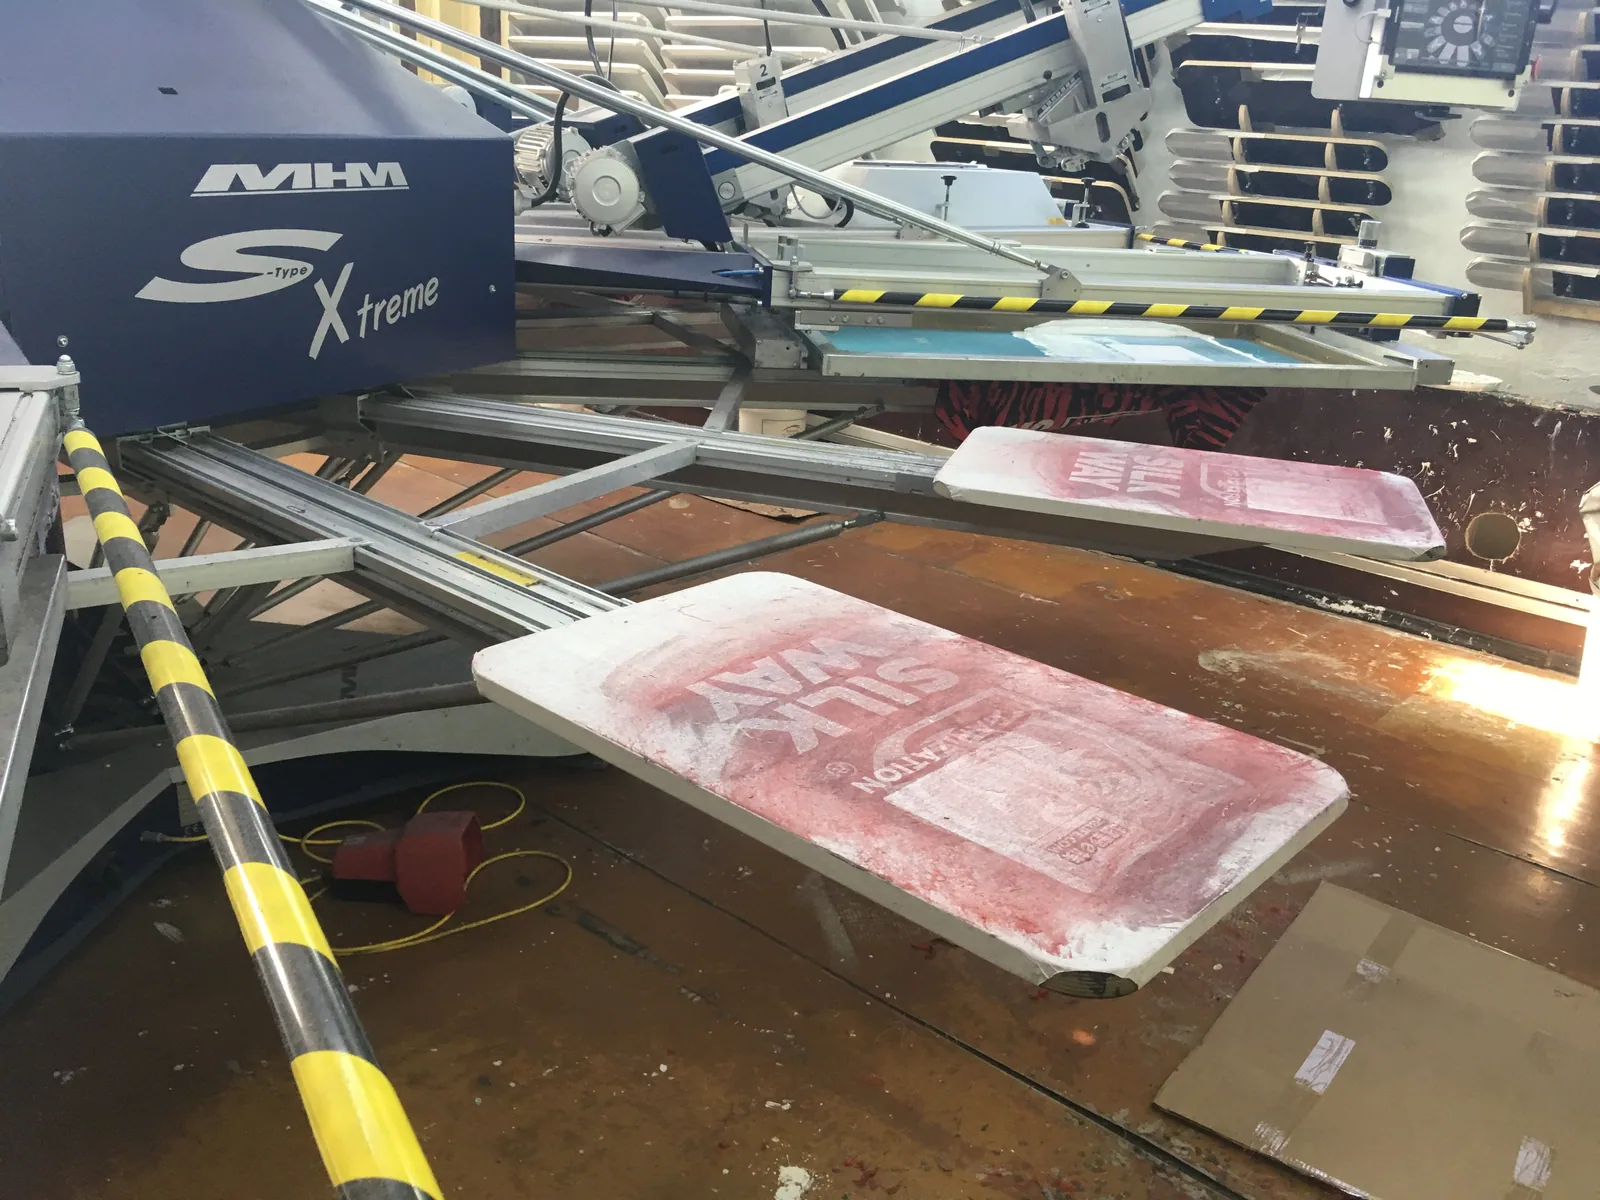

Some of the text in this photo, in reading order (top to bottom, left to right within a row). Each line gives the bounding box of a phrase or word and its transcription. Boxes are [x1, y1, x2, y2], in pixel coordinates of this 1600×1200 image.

[760, 64, 768, 77] 2
[193, 162, 408, 194] MHM
[1068, 451, 1128, 492] WAY
[1126, 454, 1185, 498] SILK
[685, 637, 895, 722] WAY
[737, 656, 960, 755] SILK
